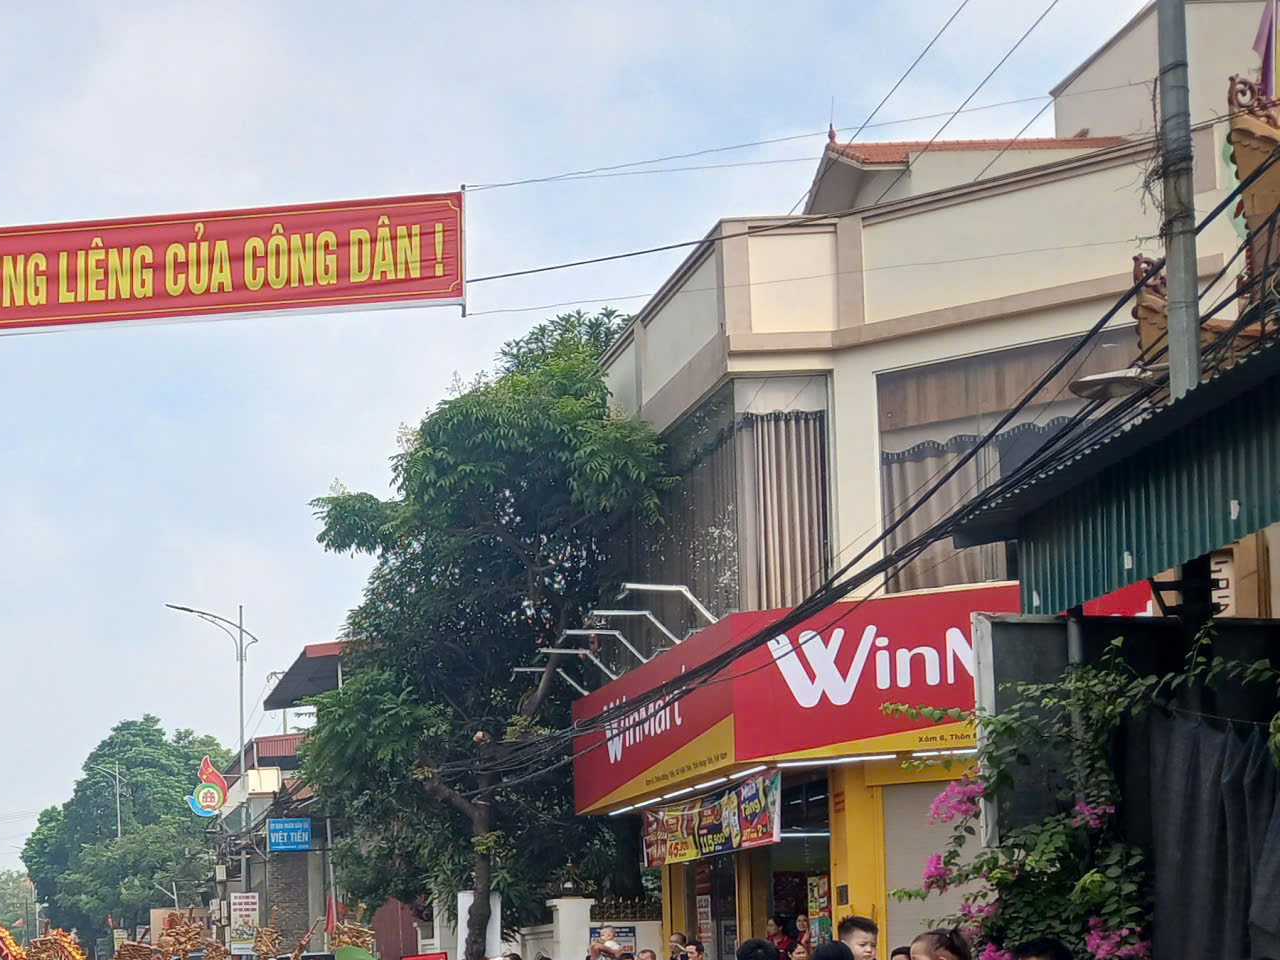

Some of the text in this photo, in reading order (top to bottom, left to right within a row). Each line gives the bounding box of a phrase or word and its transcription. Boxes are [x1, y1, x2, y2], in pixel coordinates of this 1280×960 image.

[58, 236, 154, 304] LIÊNG
[165, 222, 233, 297] CỦA
[243, 223, 338, 291] CÔNG
[349, 215, 421, 284] DÂN
[434, 222, 444, 277] !
